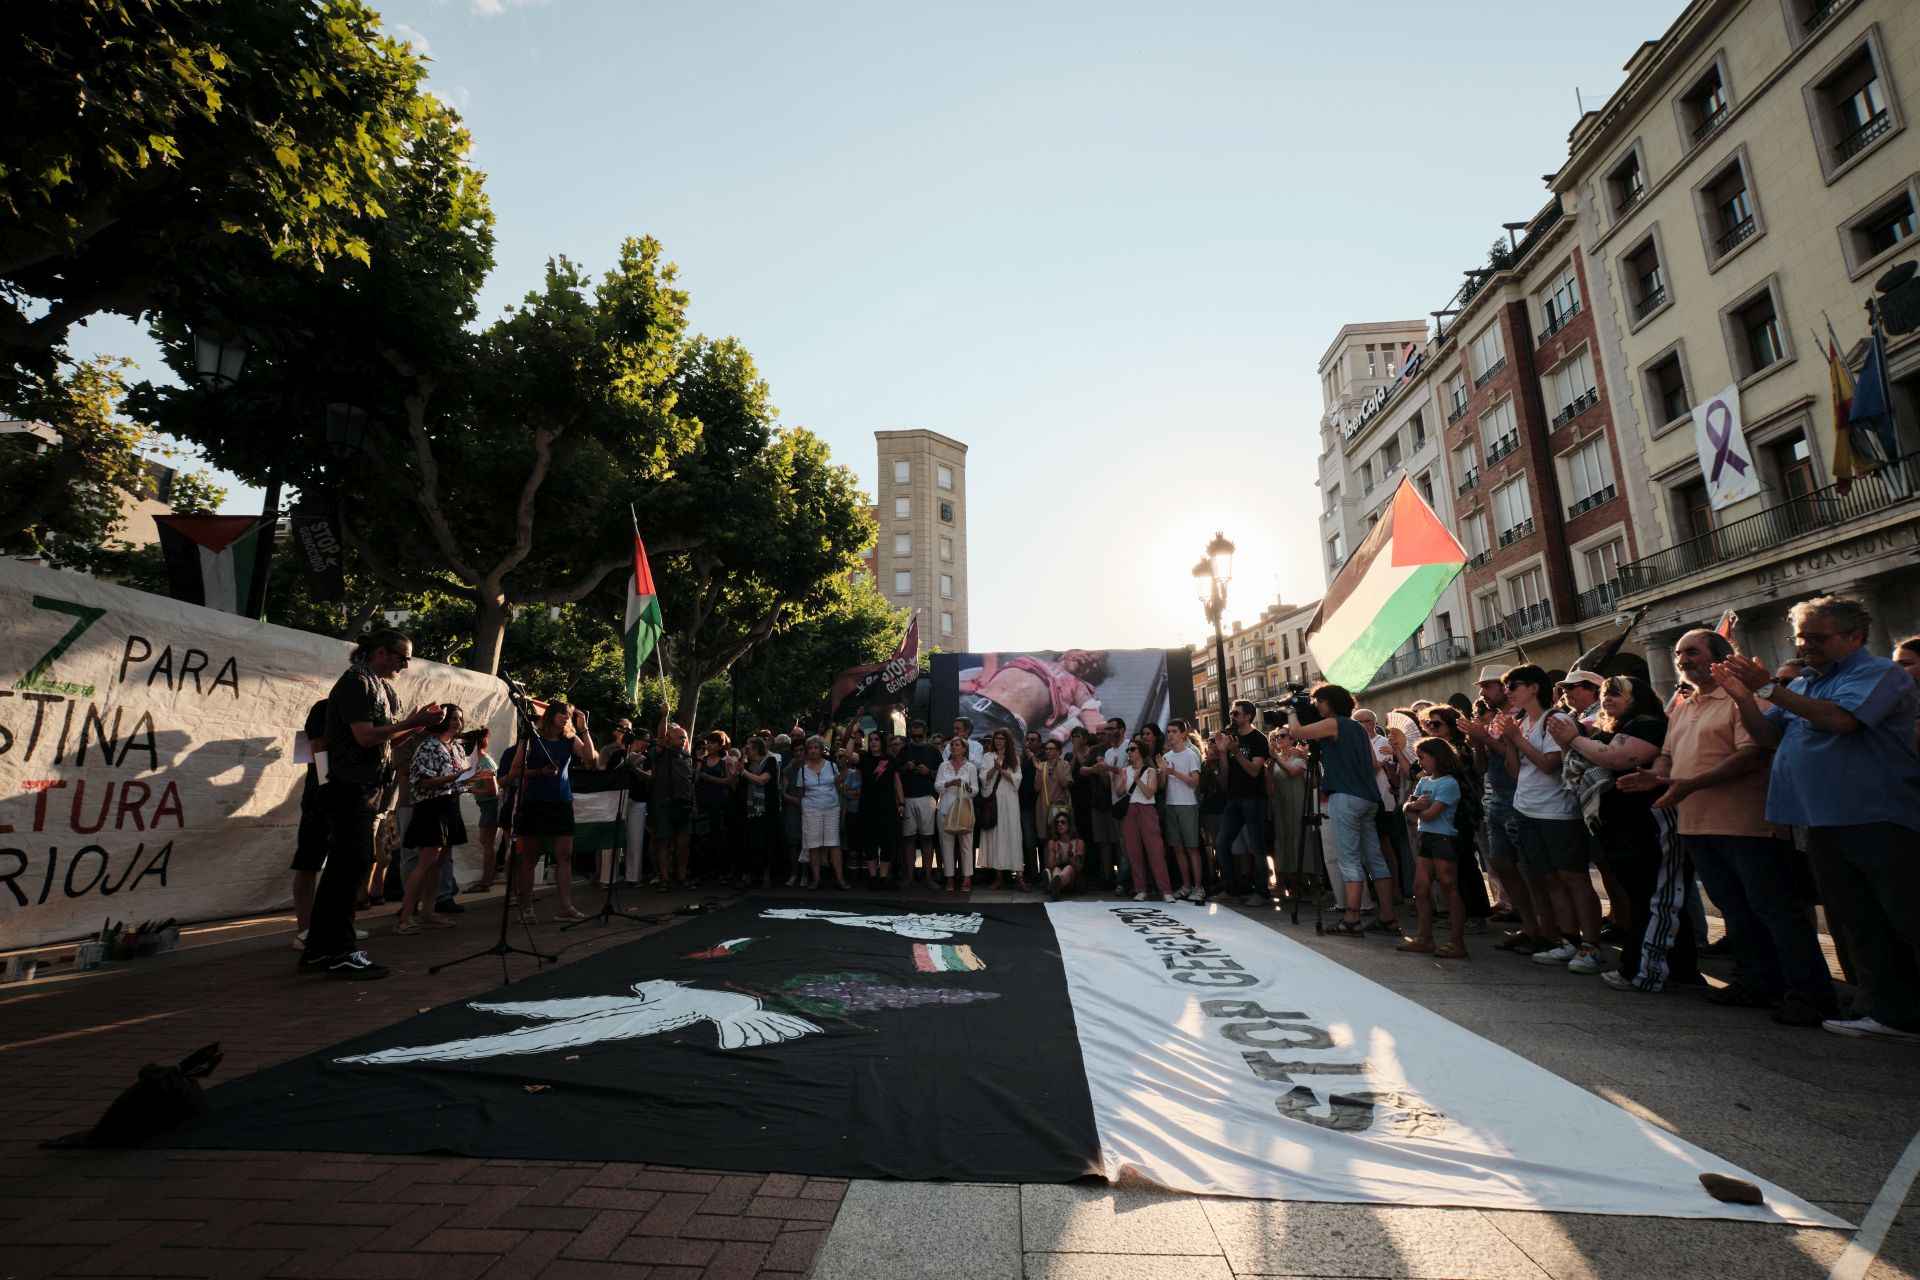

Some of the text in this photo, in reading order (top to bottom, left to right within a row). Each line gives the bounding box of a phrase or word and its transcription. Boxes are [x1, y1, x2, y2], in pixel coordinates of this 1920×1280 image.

[300, 526, 327, 572] GENOCIDIO
[310, 521, 340, 553] STOP
[1756, 532, 1894, 586] DELEGACION
[119, 635, 239, 700] PARA
[881, 657, 907, 682] STOP
[1108, 907, 1447, 1138] STOP GENOCIDIO
